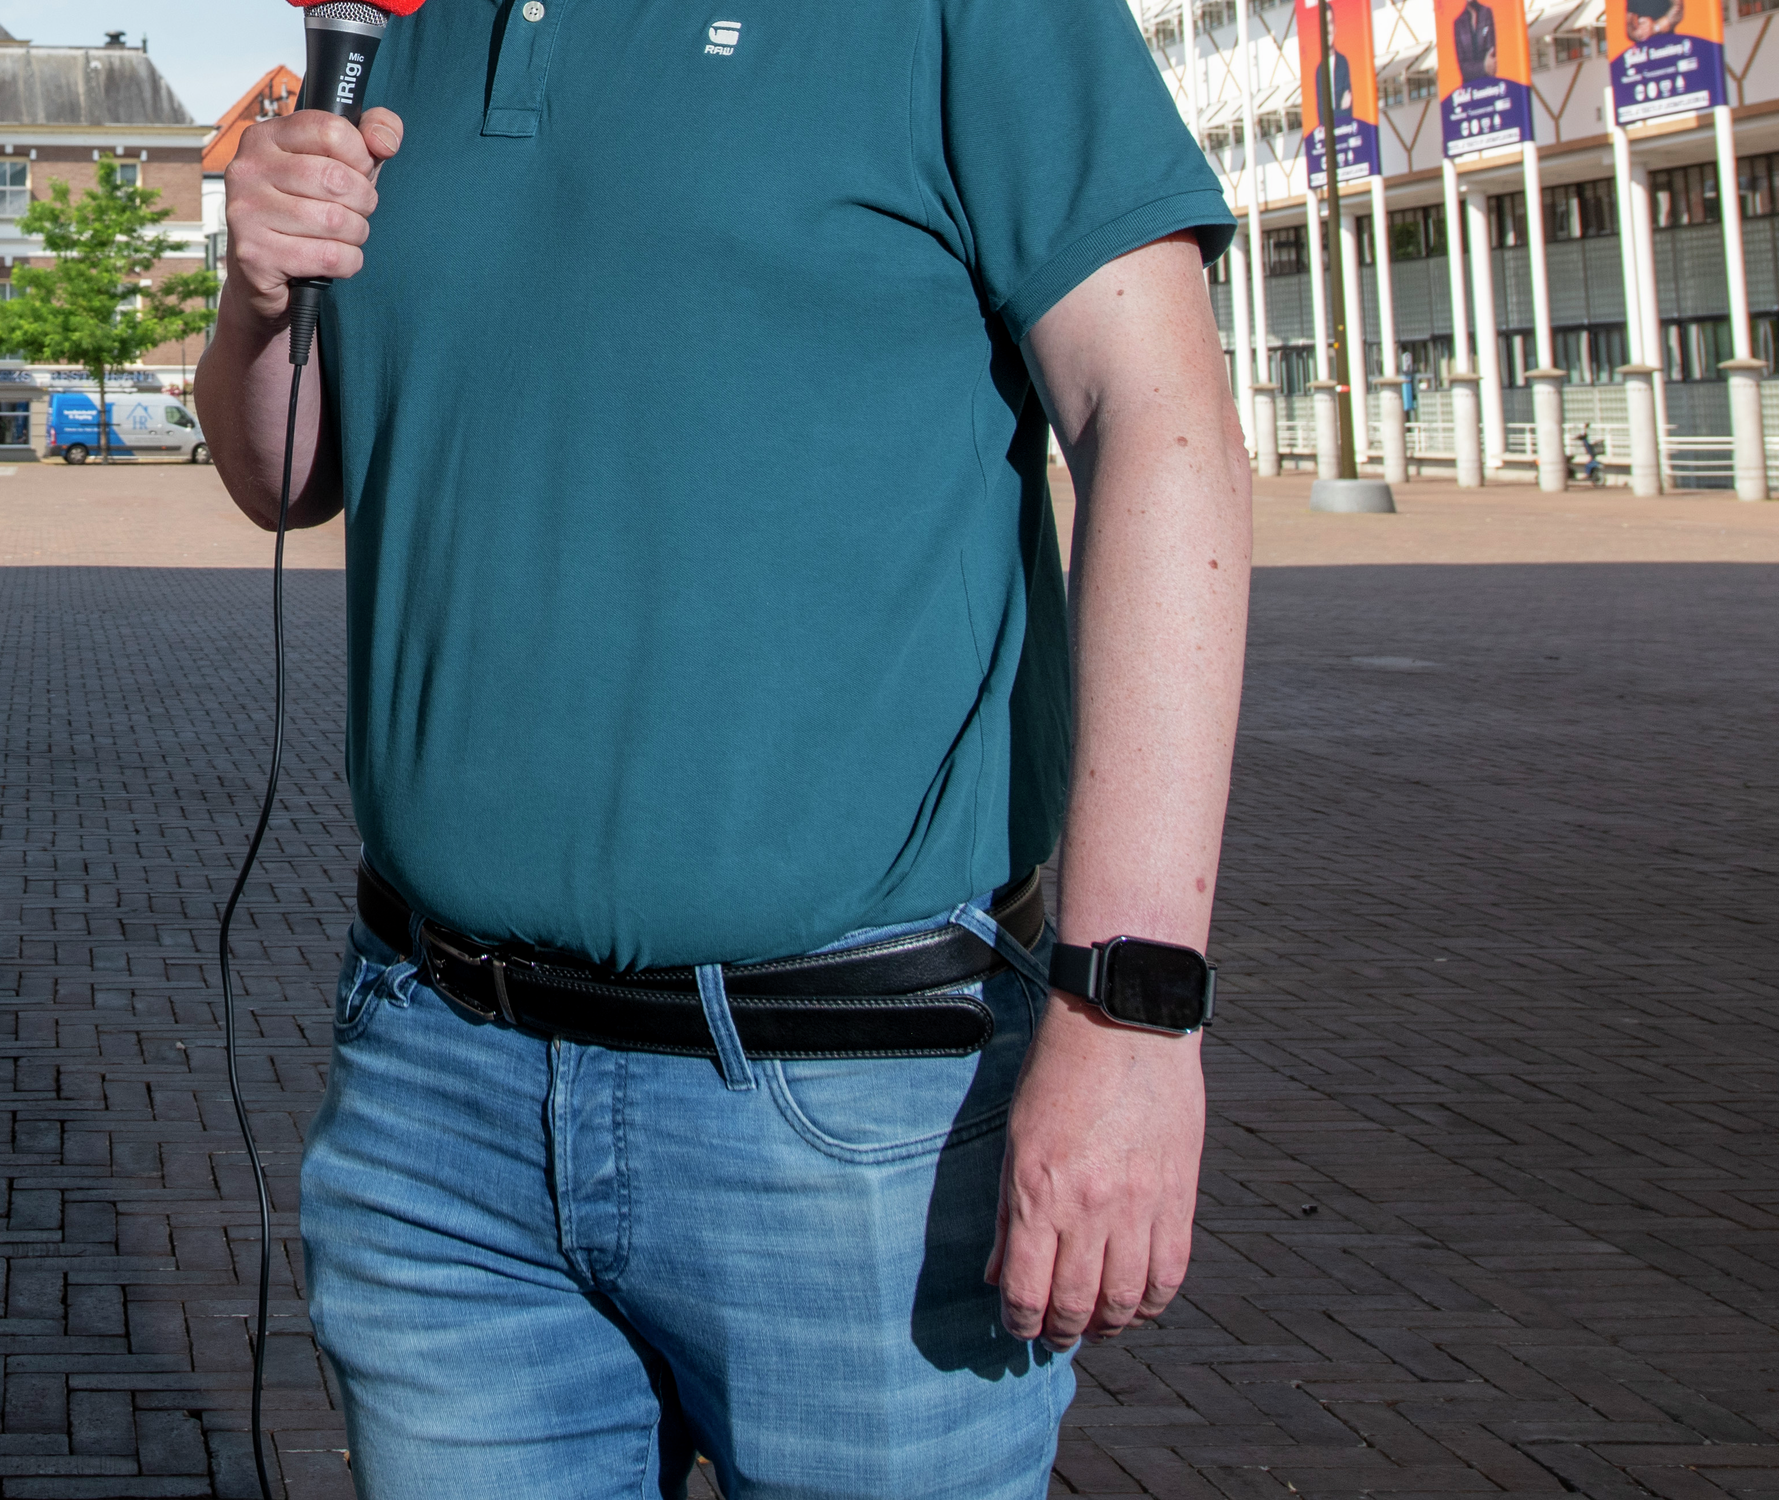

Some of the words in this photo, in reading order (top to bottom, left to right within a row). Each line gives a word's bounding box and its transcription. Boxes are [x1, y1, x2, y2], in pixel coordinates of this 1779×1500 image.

[704, 44, 734, 56] RAW
[348, 52, 365, 63] Mic
[336, 62, 362, 106] iRig
